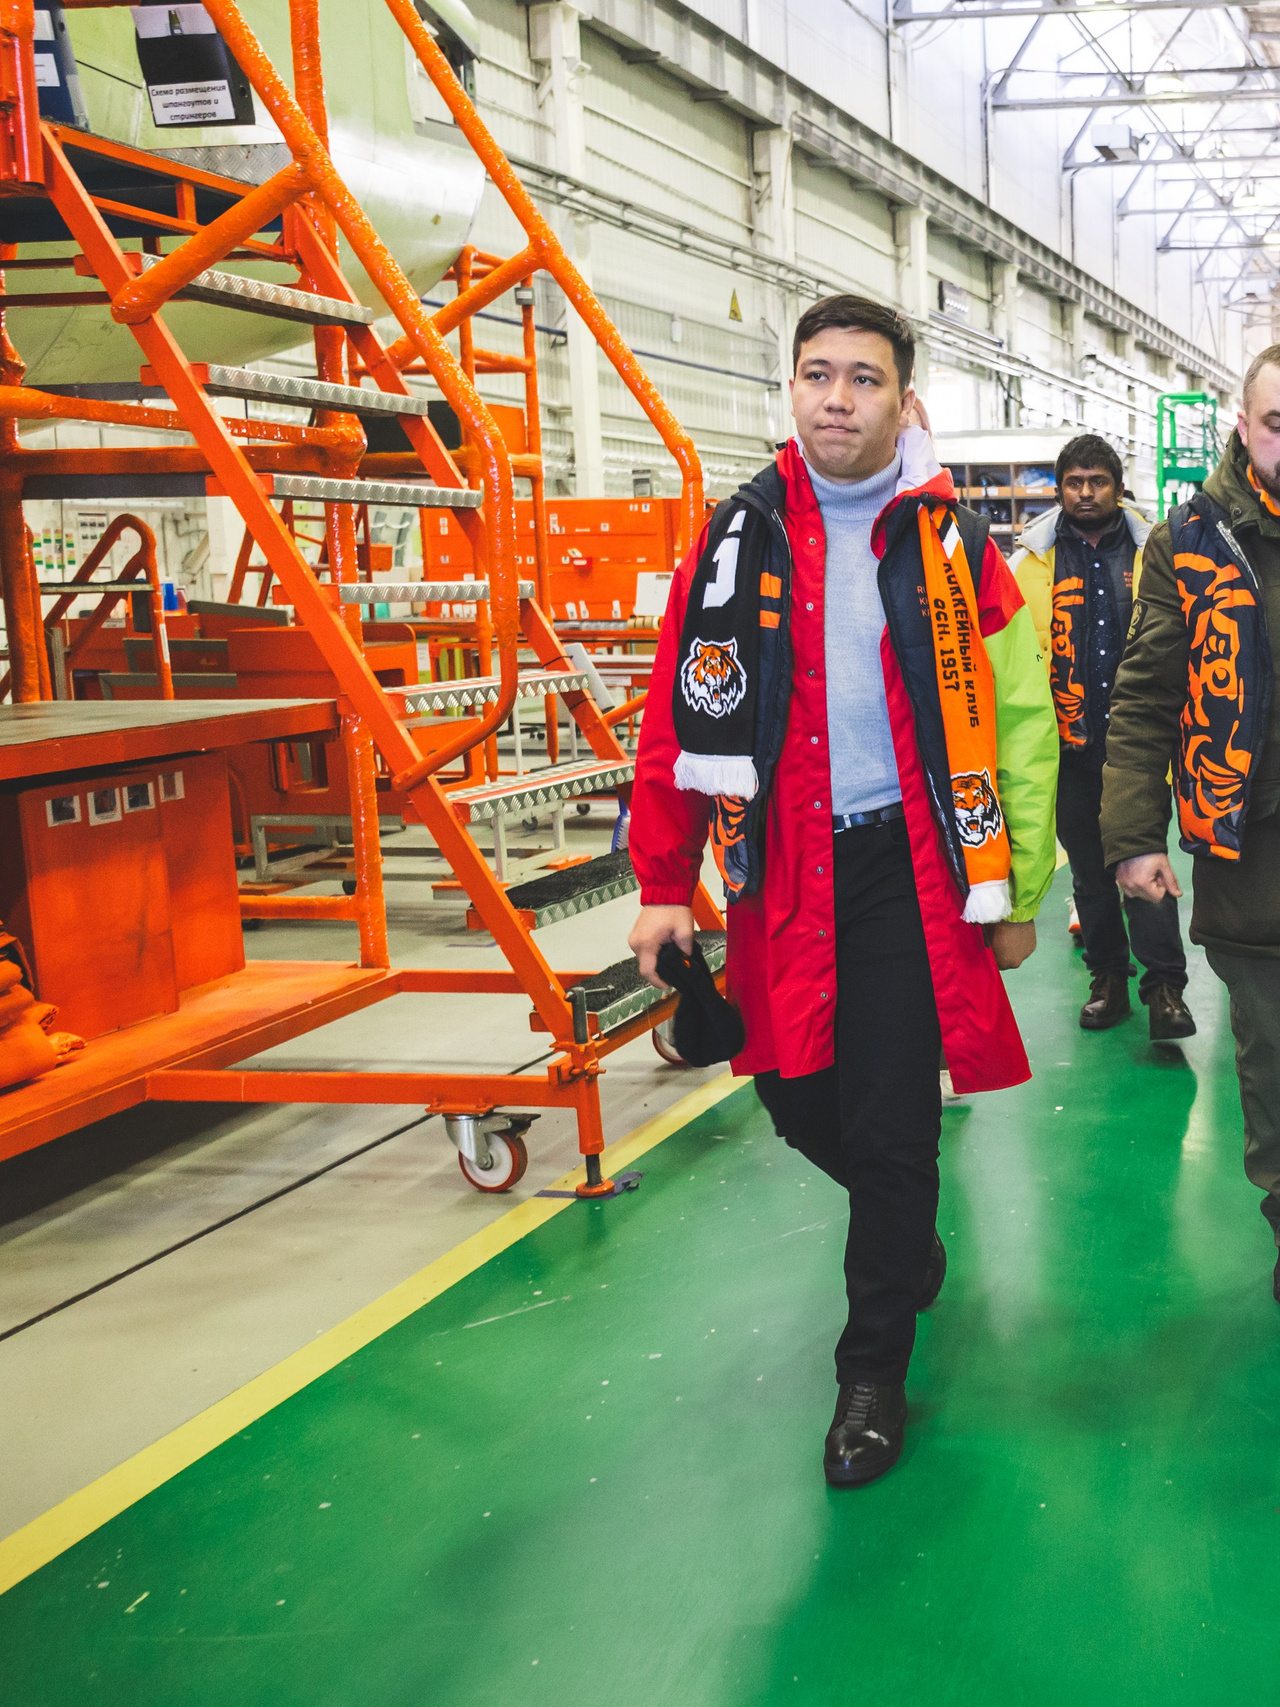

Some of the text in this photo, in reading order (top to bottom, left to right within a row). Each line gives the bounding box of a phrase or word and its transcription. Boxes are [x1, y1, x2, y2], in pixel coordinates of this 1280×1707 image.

[151, 85, 227, 97] Схема размещения
[162, 99, 212, 109] шпангоутов
[170, 111, 217, 121] стрингеров
[933, 598, 960, 692] ОСН. 1957
[964, 680, 980, 728] КЛУБ
